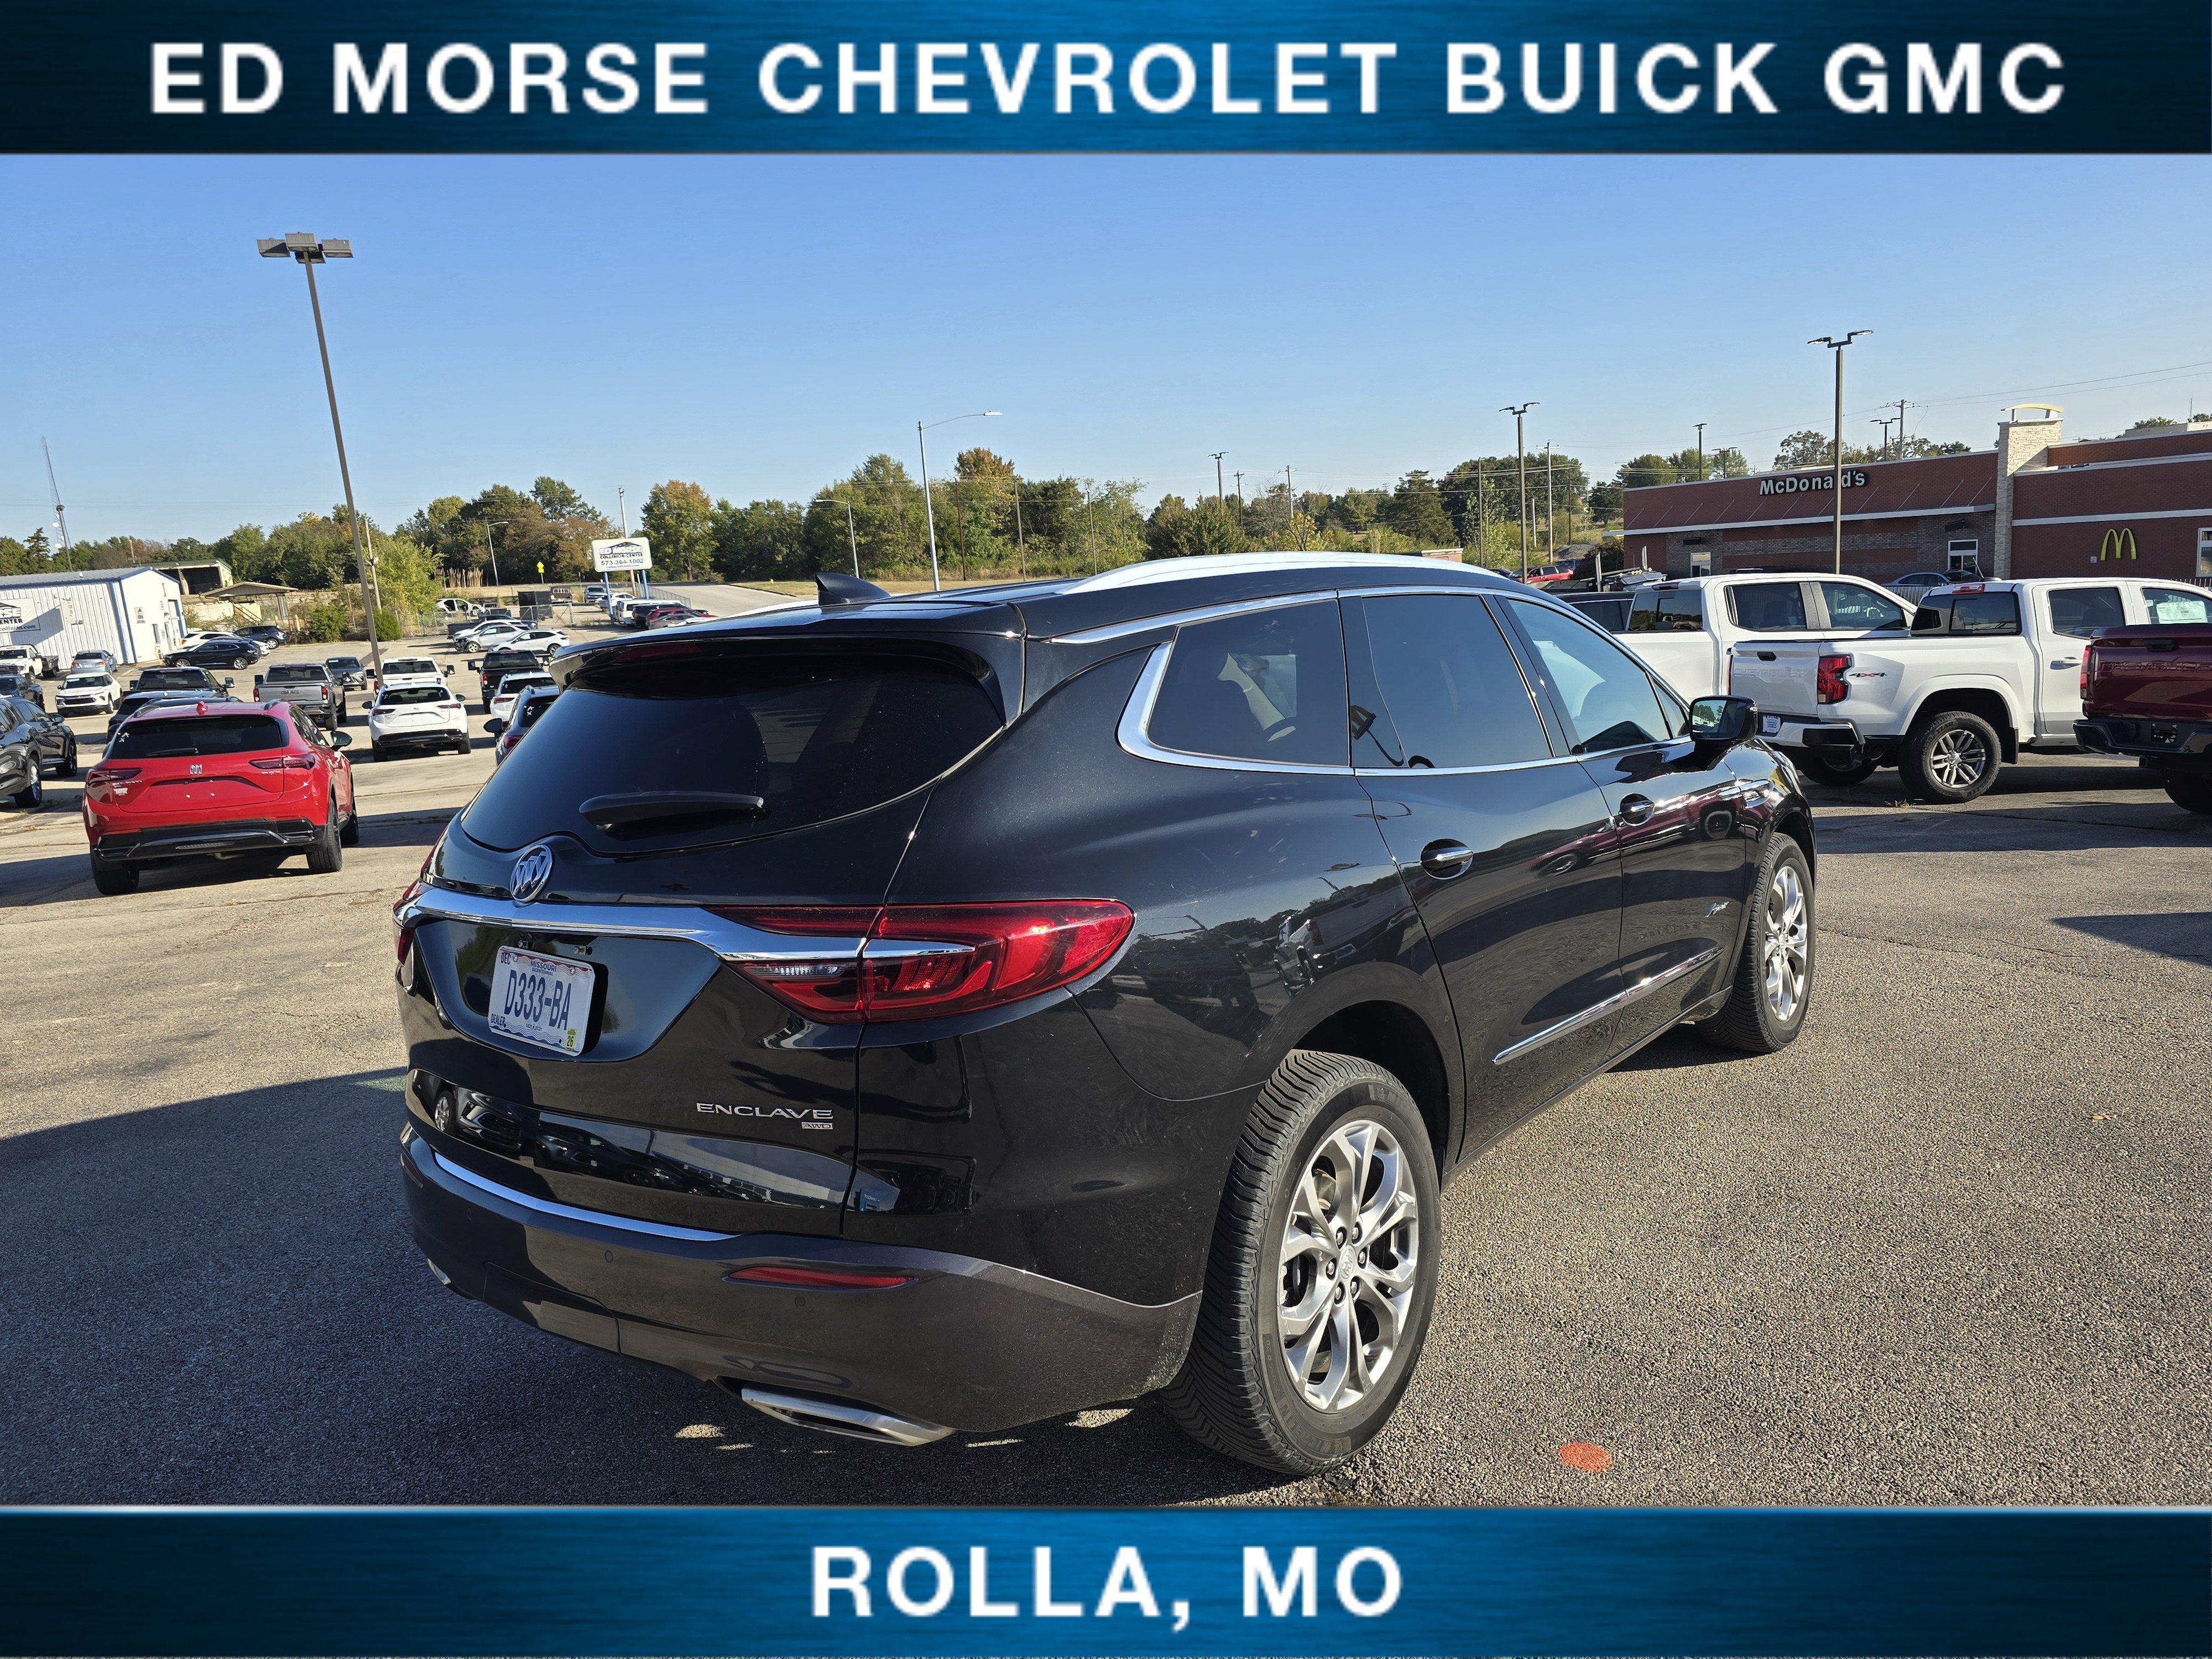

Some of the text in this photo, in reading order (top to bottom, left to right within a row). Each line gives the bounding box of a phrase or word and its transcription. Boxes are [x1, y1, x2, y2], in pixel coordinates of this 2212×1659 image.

[1759, 471, 1865, 495] McDonad's
[612, 546, 642, 554] MORSE
[500, 952, 511, 965] DEC
[530, 961, 557, 972] MISSOURI
[504, 969, 571, 1031] D333-BA
[491, 1013, 506, 1026] DEALER
[566, 1035, 574, 1047] 26
[696, 1102, 834, 1120] ENCLAVE
